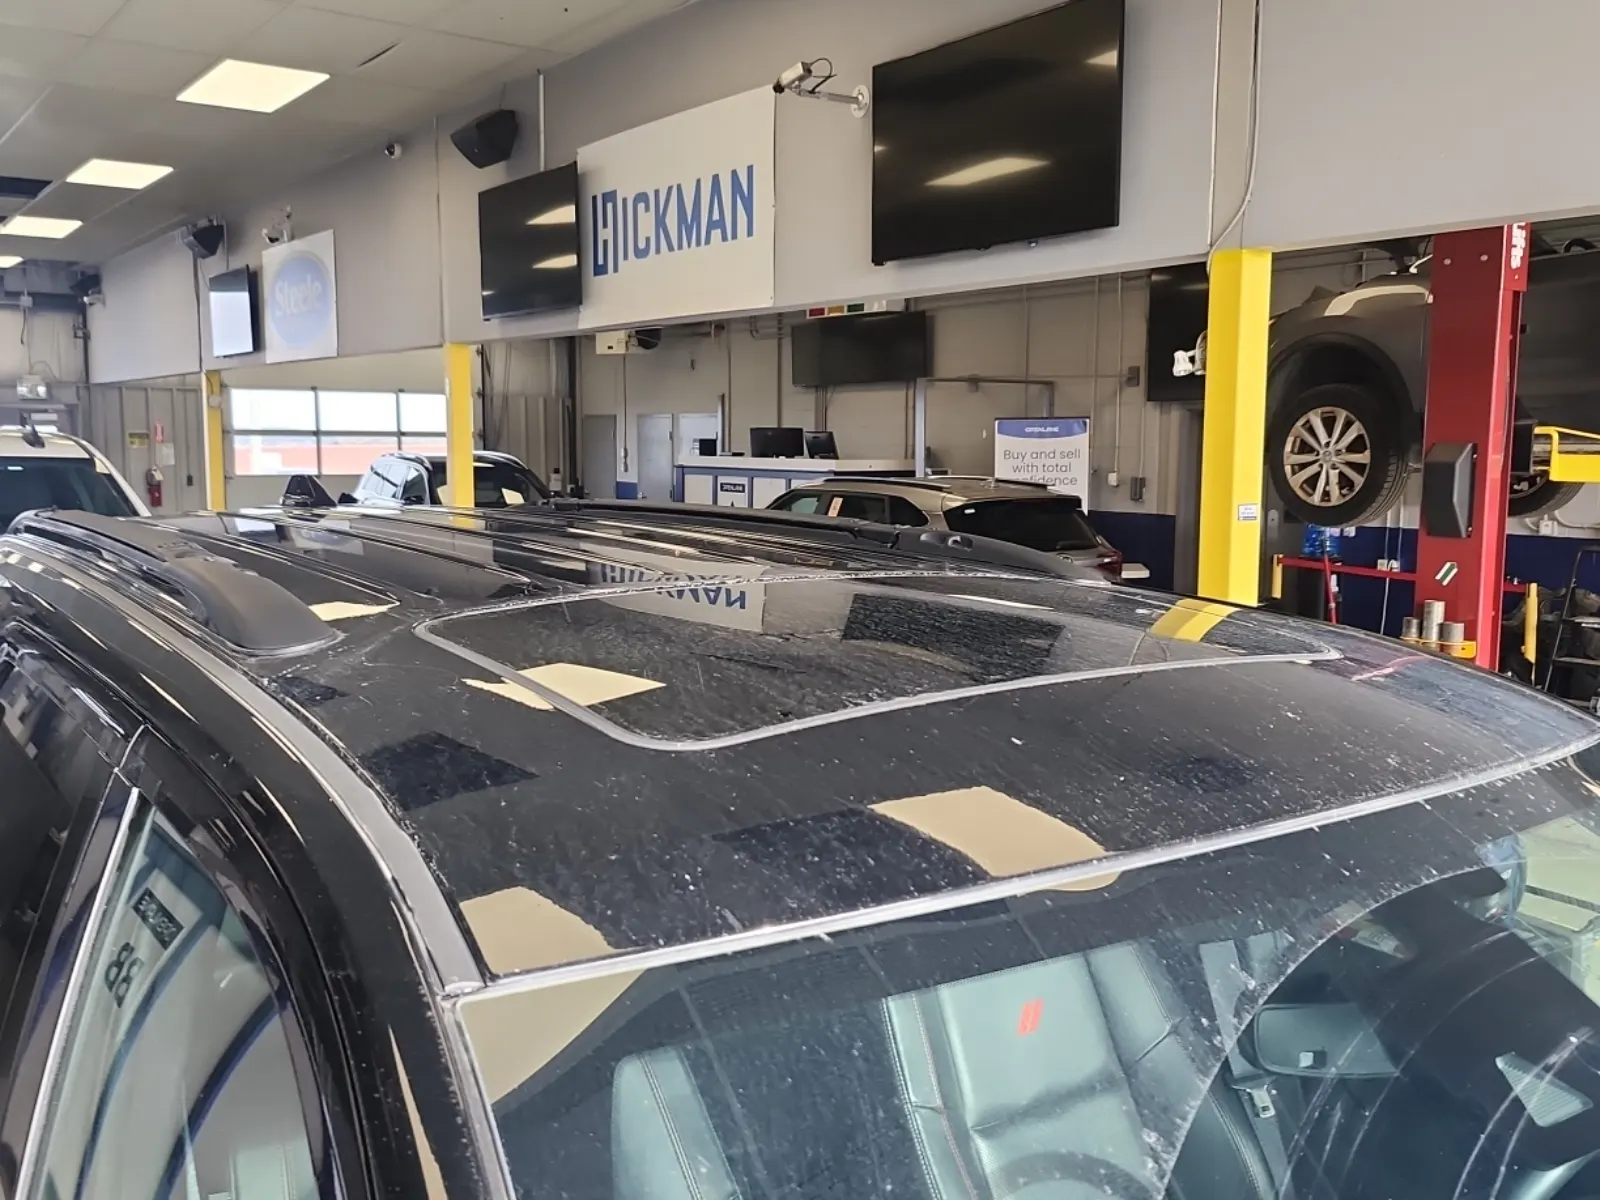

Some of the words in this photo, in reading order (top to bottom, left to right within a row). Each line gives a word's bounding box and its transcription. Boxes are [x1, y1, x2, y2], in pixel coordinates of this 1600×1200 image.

[592, 164, 754, 277] HICKMAN
[274, 273, 323, 317] Steele
[1003, 449, 1028, 463] Buy
[1030, 449, 1056, 460] and
[1060, 448, 1081, 460] sell
[1012, 462, 1039, 473] with
[1042, 462, 1072, 473] total
